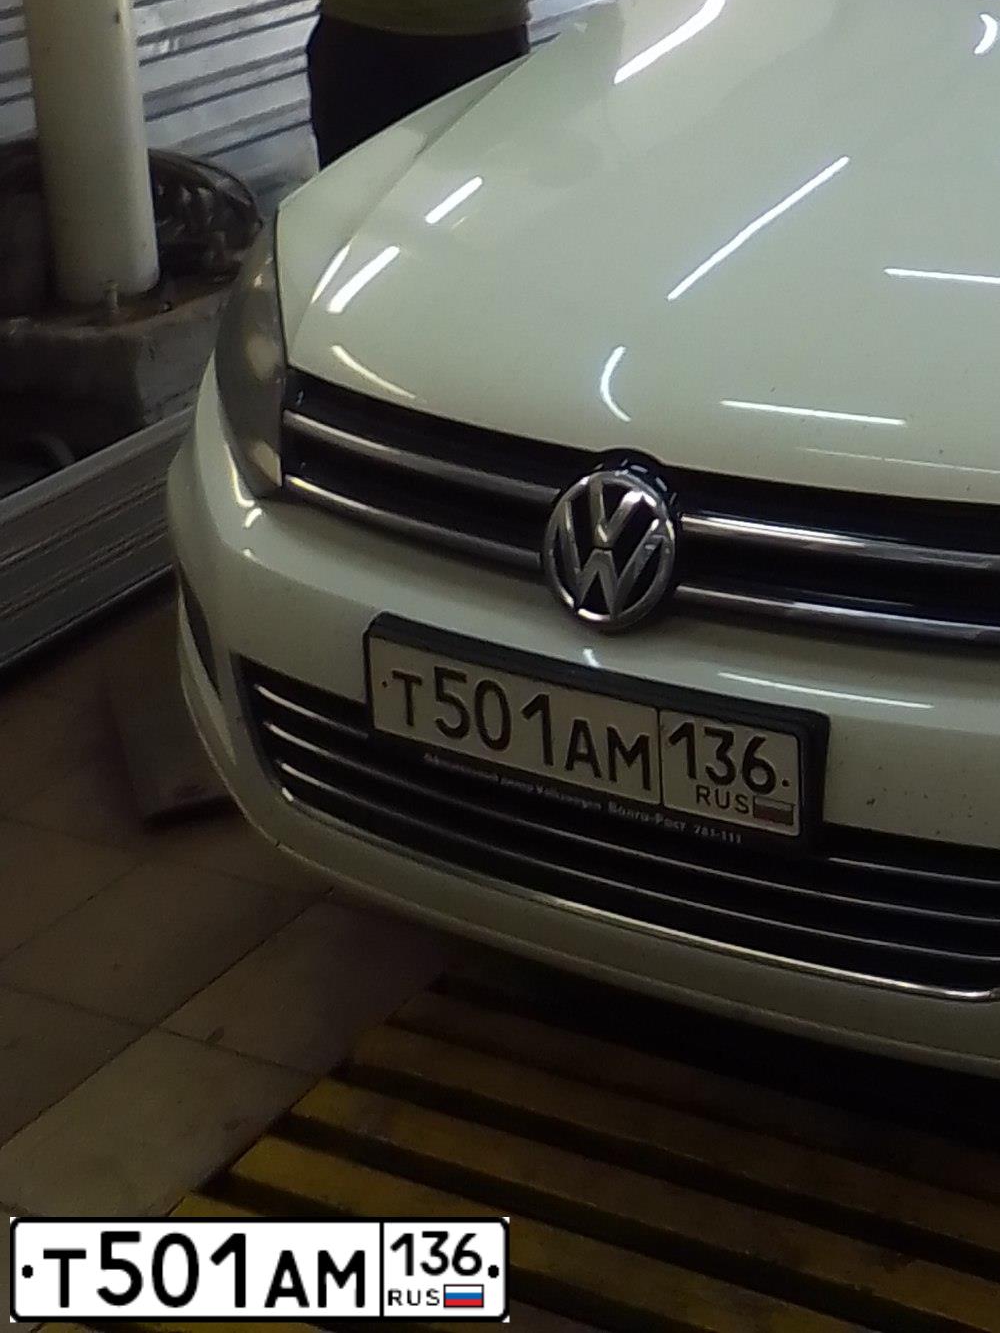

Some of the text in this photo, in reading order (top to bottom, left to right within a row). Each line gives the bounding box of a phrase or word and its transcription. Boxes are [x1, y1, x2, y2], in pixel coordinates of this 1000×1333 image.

[391, 666, 651, 791] Т501АМ
[668, 721, 778, 795] 136
[696, 784, 749, 814] RUS
